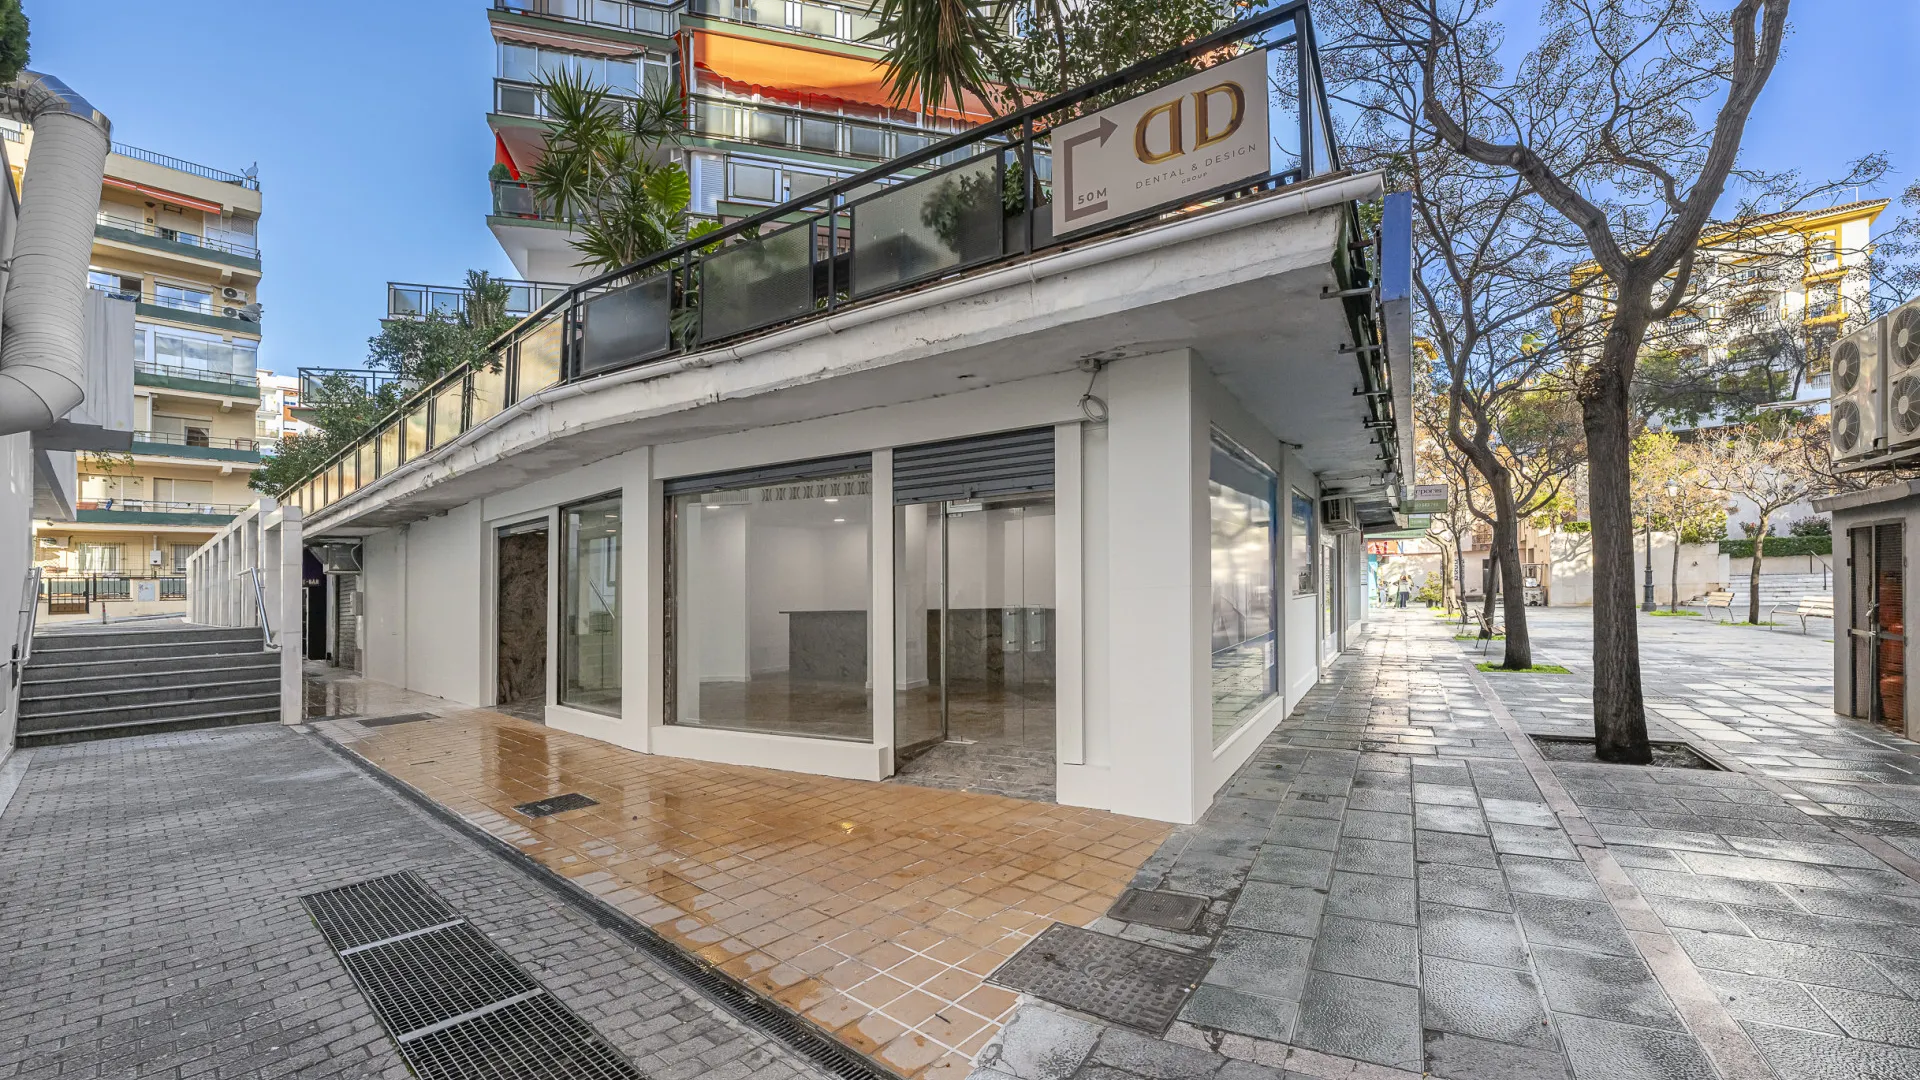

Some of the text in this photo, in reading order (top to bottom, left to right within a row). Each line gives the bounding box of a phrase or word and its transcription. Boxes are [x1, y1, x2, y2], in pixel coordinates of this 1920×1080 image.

[1136, 143, 1257, 189] DENTAL & DESIGN
[1181, 172, 1208, 184] GROUP
[1078, 188, 1107, 205] 50M
